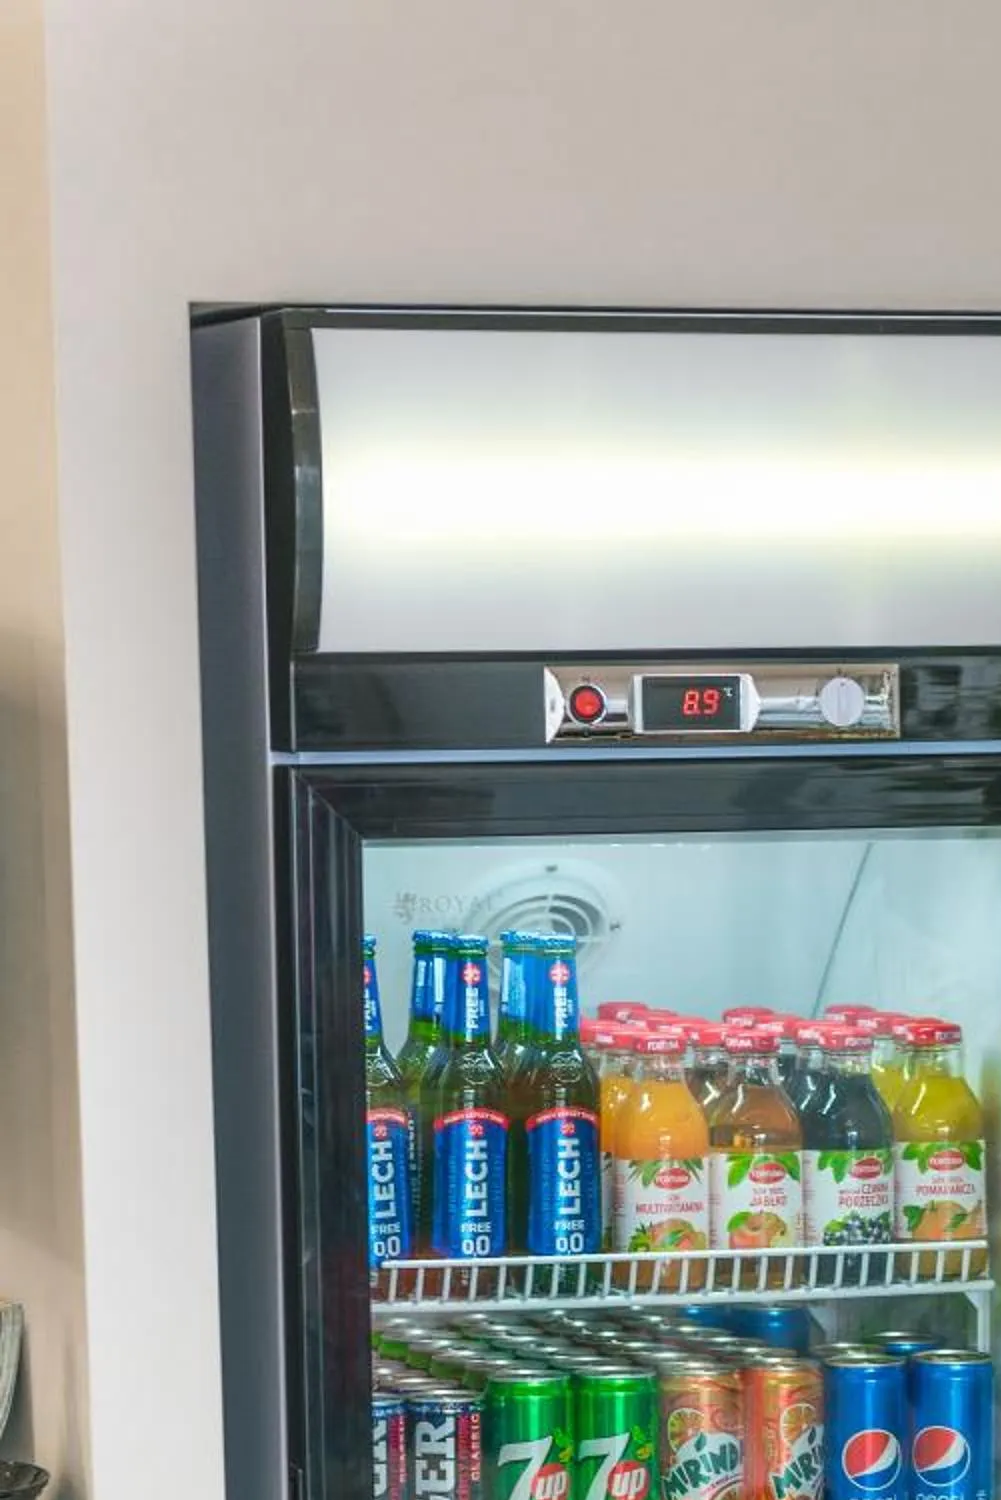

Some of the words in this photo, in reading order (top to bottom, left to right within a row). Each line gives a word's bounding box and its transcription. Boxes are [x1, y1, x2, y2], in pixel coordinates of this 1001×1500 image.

[372, 1139, 397, 1218] LECH
[465, 1139, 489, 1217] LECH
[556, 1137, 582, 1216] LECH
[372, 1222, 400, 1235] FREE
[461, 1221, 492, 1233] FREE
[553, 1219, 585, 1231] FREE
